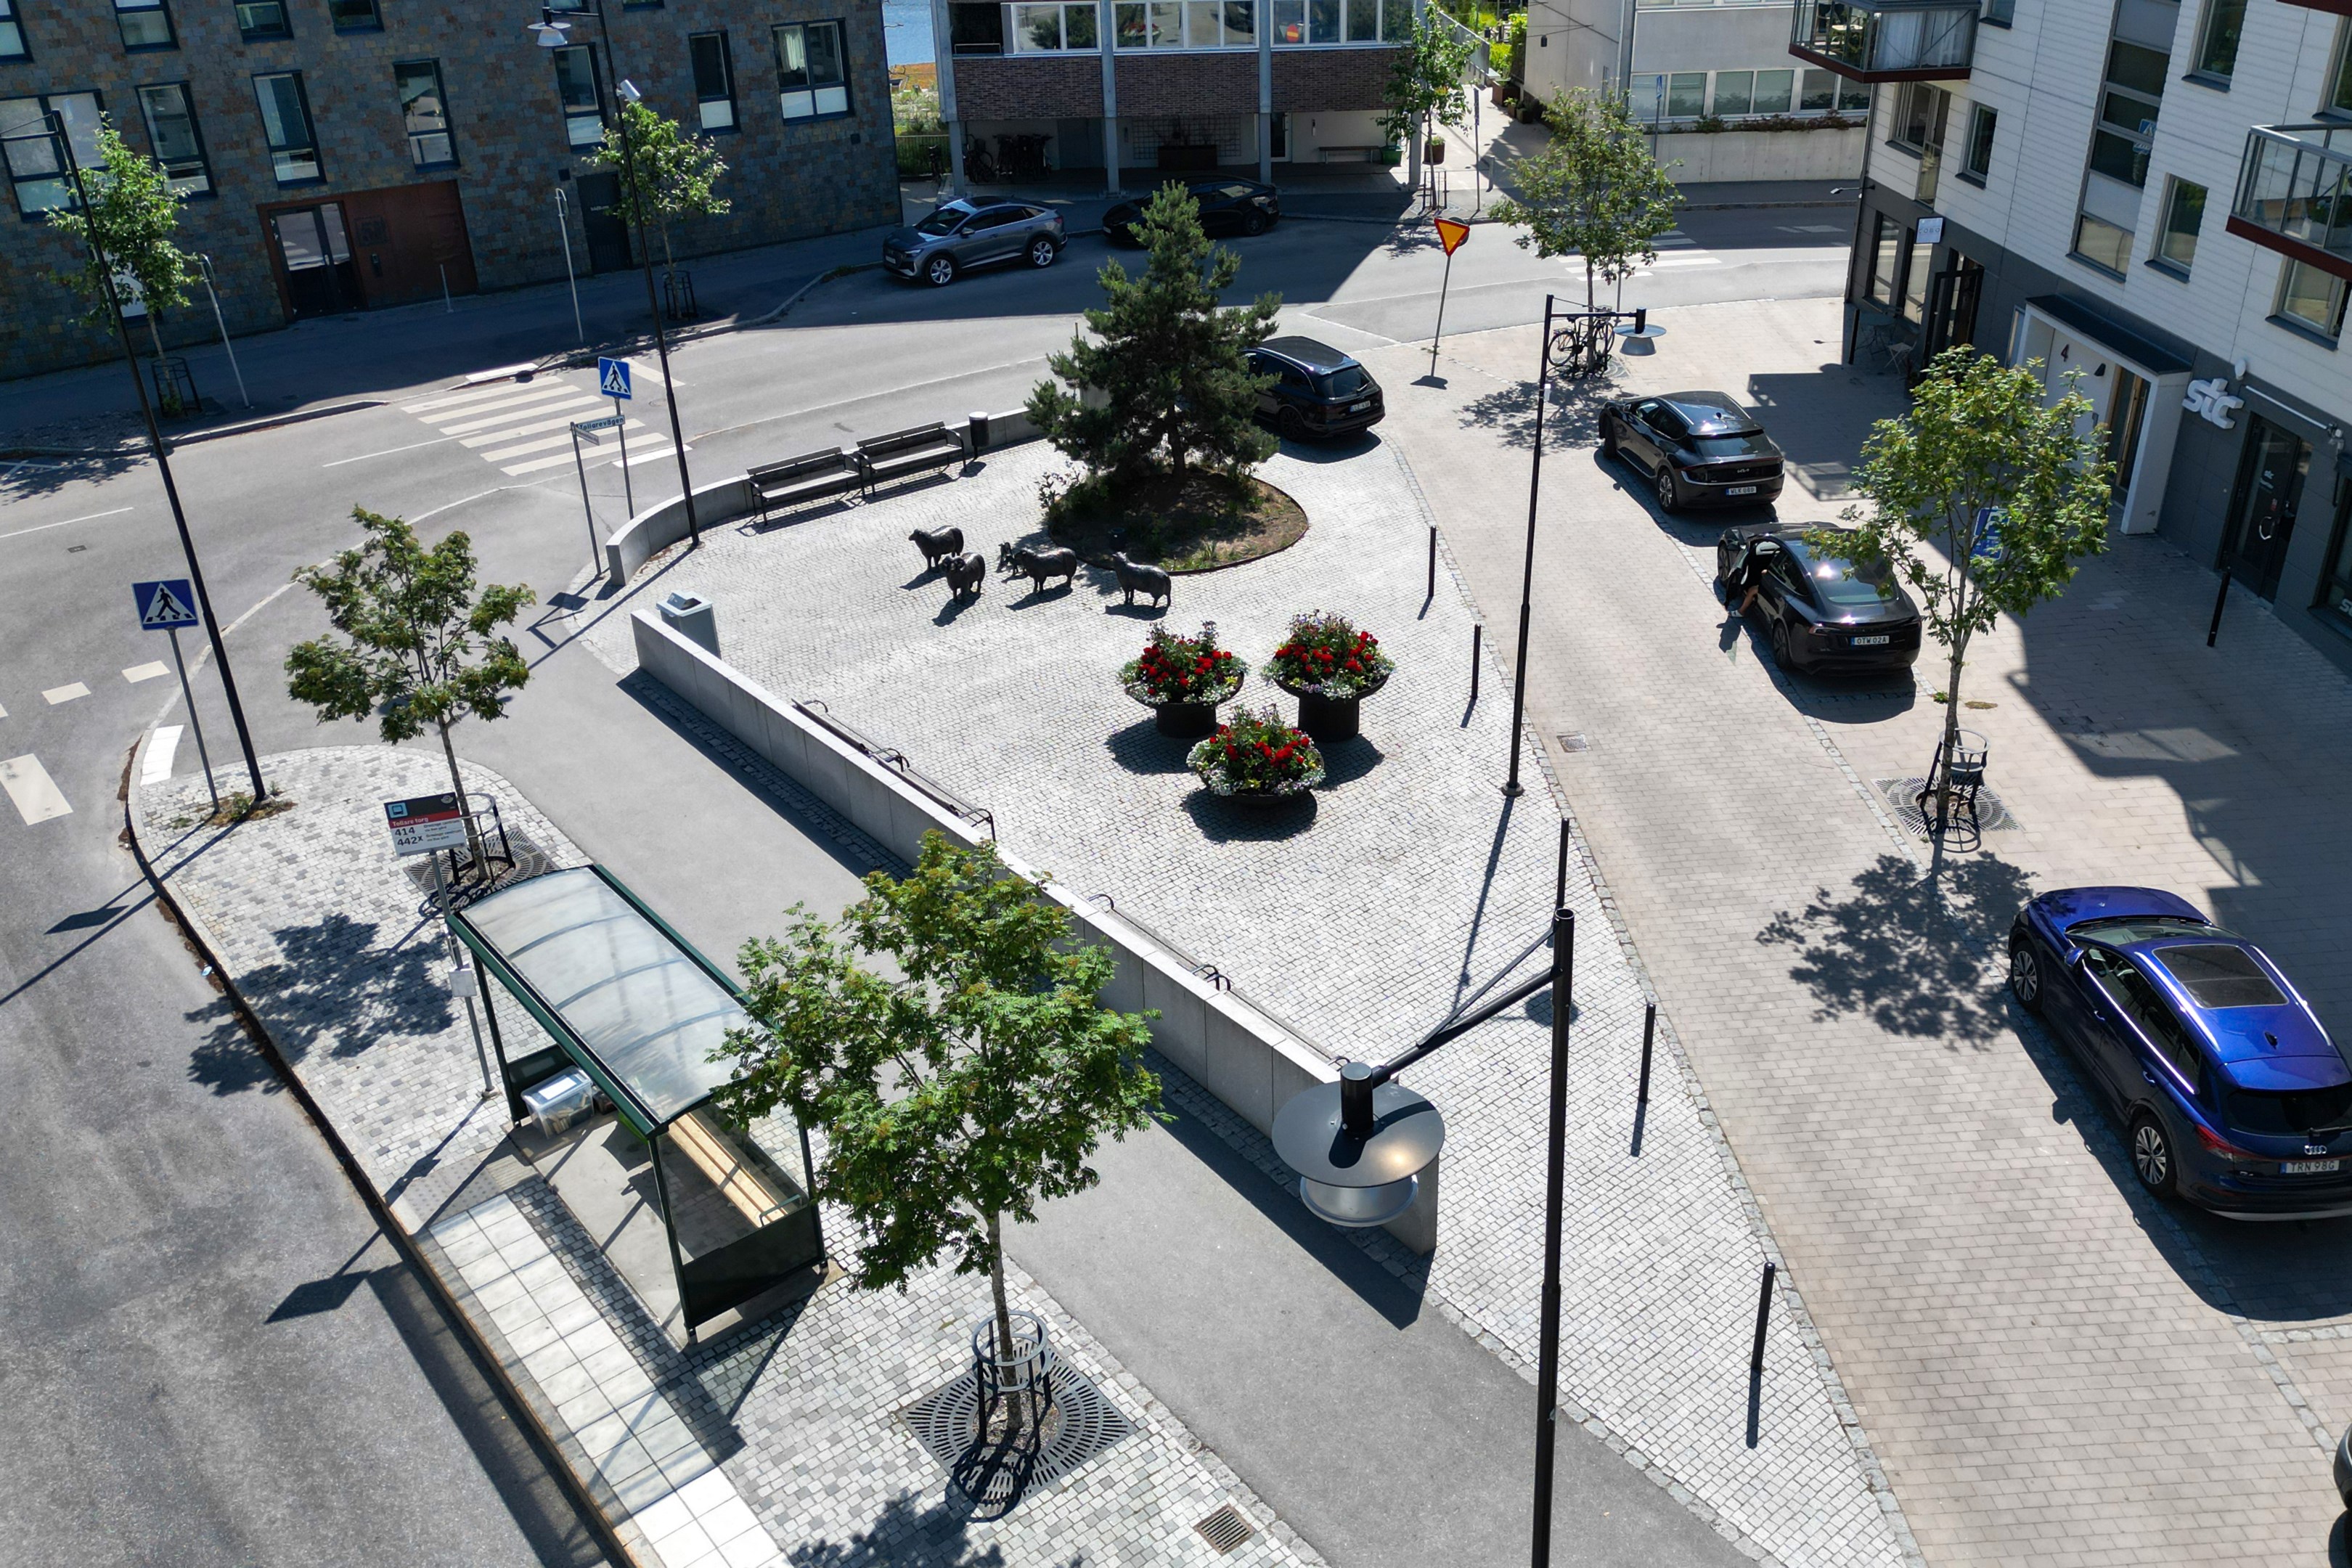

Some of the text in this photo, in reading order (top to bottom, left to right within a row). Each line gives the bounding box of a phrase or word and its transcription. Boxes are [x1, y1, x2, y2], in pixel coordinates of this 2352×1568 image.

[2060, 344, 2070, 362] 4
[2181, 377, 2245, 430] stc
[579, 417, 624, 430] Tollarevägen
[392, 818, 415, 827] Tollare
[395, 827, 416, 836] 414
[2290, 1161, 2335, 1172] TRN 98G
